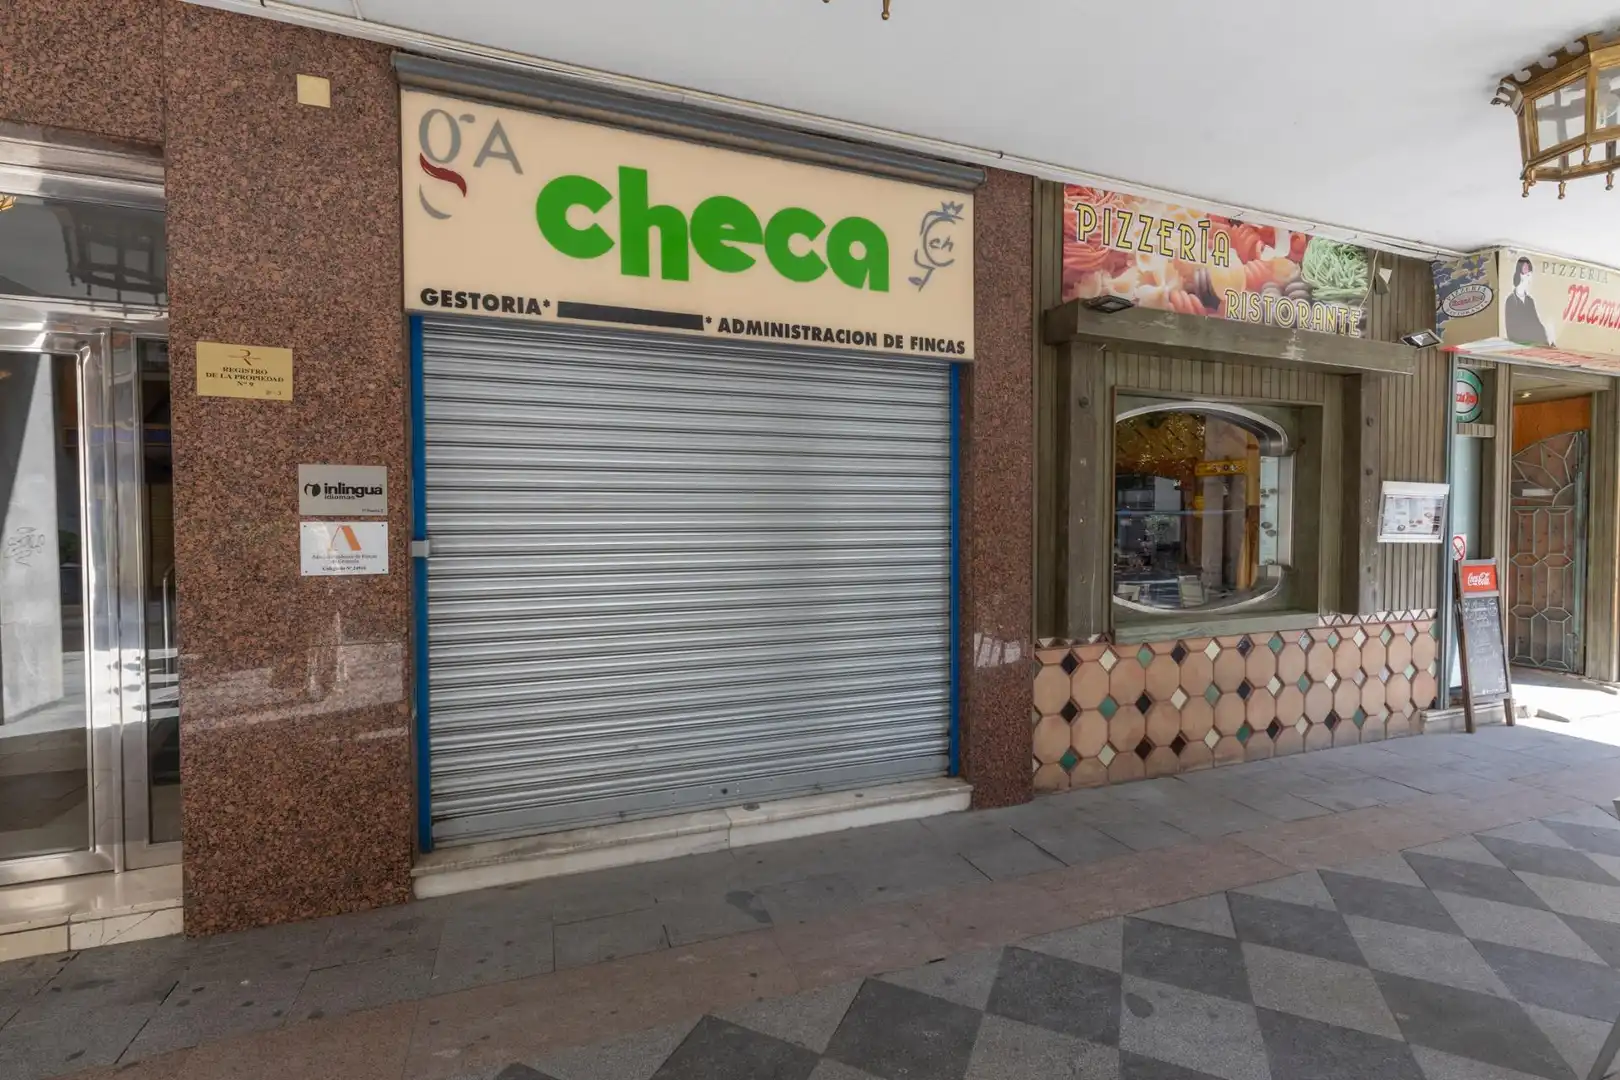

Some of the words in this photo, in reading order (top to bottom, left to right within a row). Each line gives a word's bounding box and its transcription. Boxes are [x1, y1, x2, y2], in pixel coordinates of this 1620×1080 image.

[536, 165, 890, 292] checa
[1542, 261, 1609, 284] PIZZERIA
[1225, 289, 1362, 337] RISTORANTE
[718, 317, 877, 346] ADMINISTRACION
[883, 334, 904, 349] DE
[910, 336, 965, 355] FINCAS
[222, 366, 268, 375] REGISTRO
[234, 374, 284, 383] PROPIEDAD
[324, 482, 383, 498] inlingua
